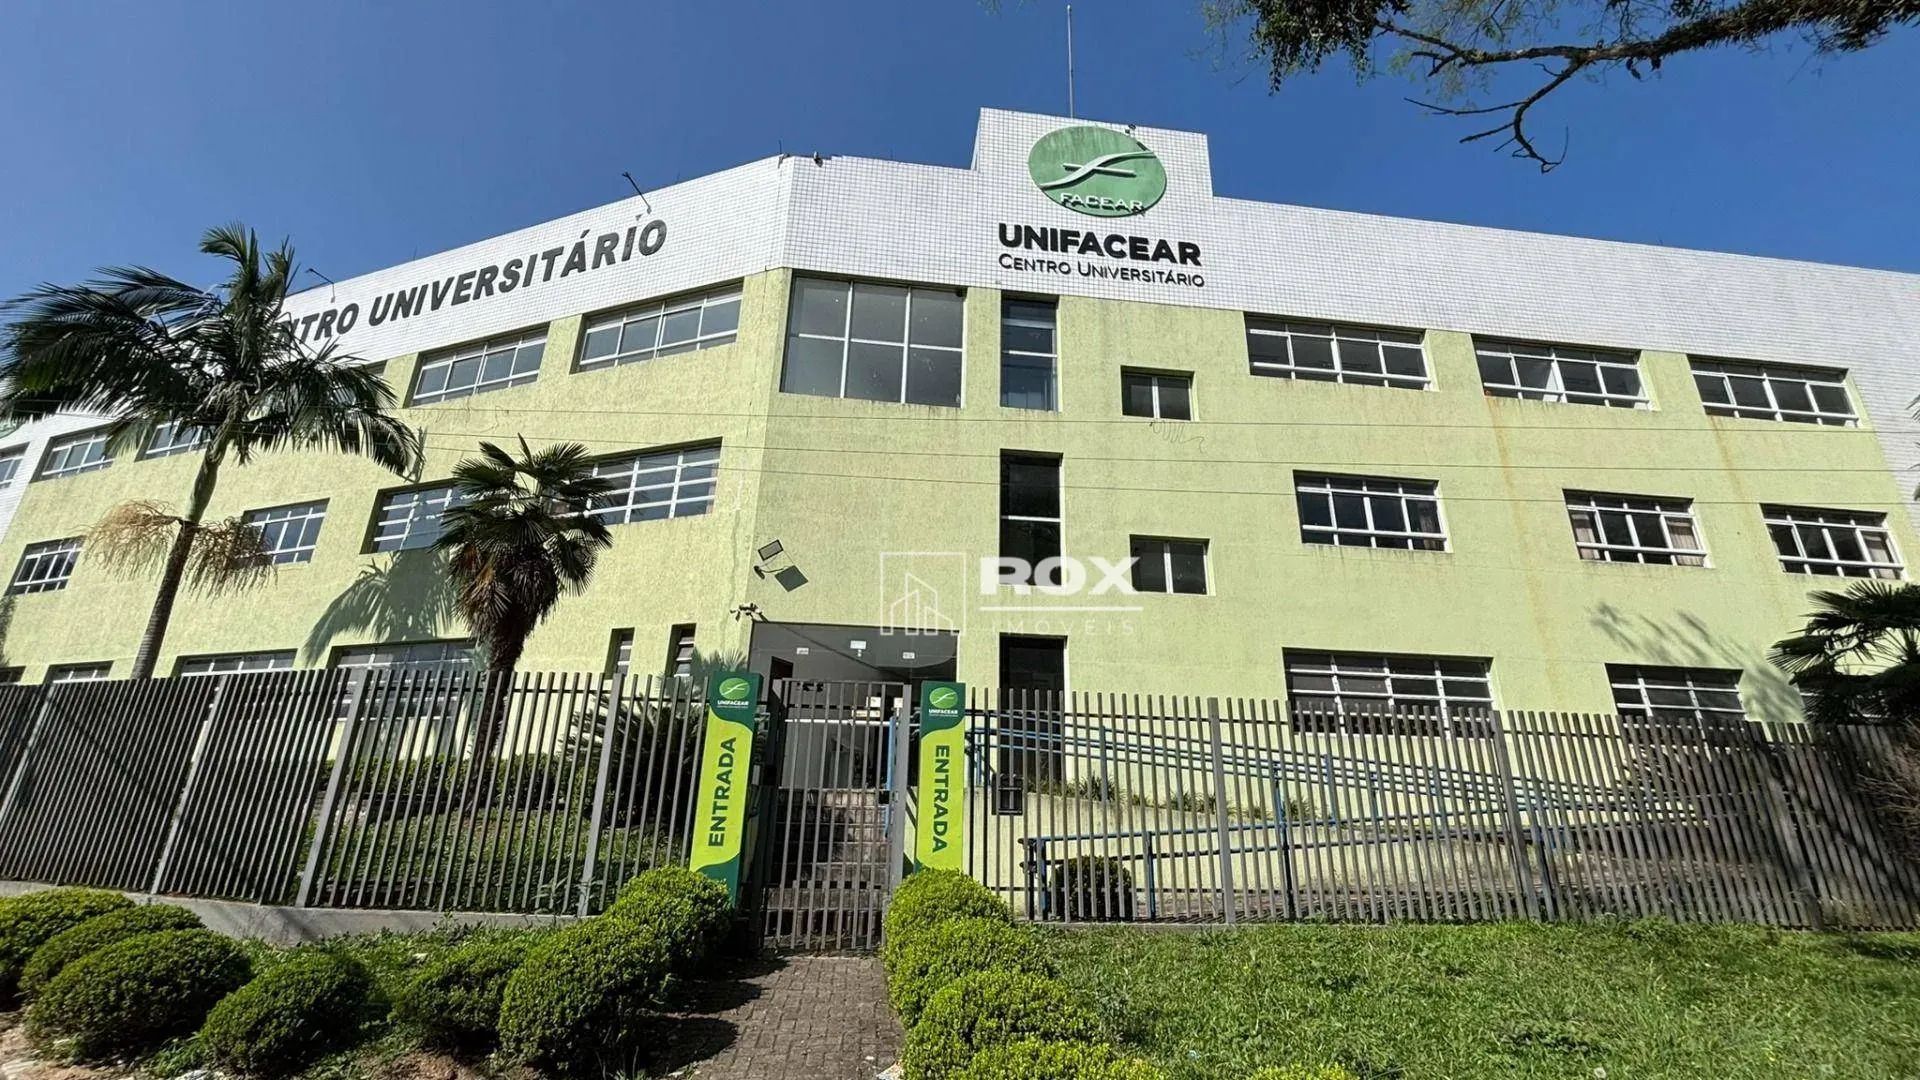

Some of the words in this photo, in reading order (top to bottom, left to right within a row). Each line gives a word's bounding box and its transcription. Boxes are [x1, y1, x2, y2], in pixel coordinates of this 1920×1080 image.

[998, 222, 1203, 267] UNIFACEAR
[1060, 192, 1143, 212] FACEAR
[368, 219, 669, 327] UNIVERSITÁRIO
[707, 737, 738, 847] ENTRADA
[931, 744, 951, 854] ENTRADA
